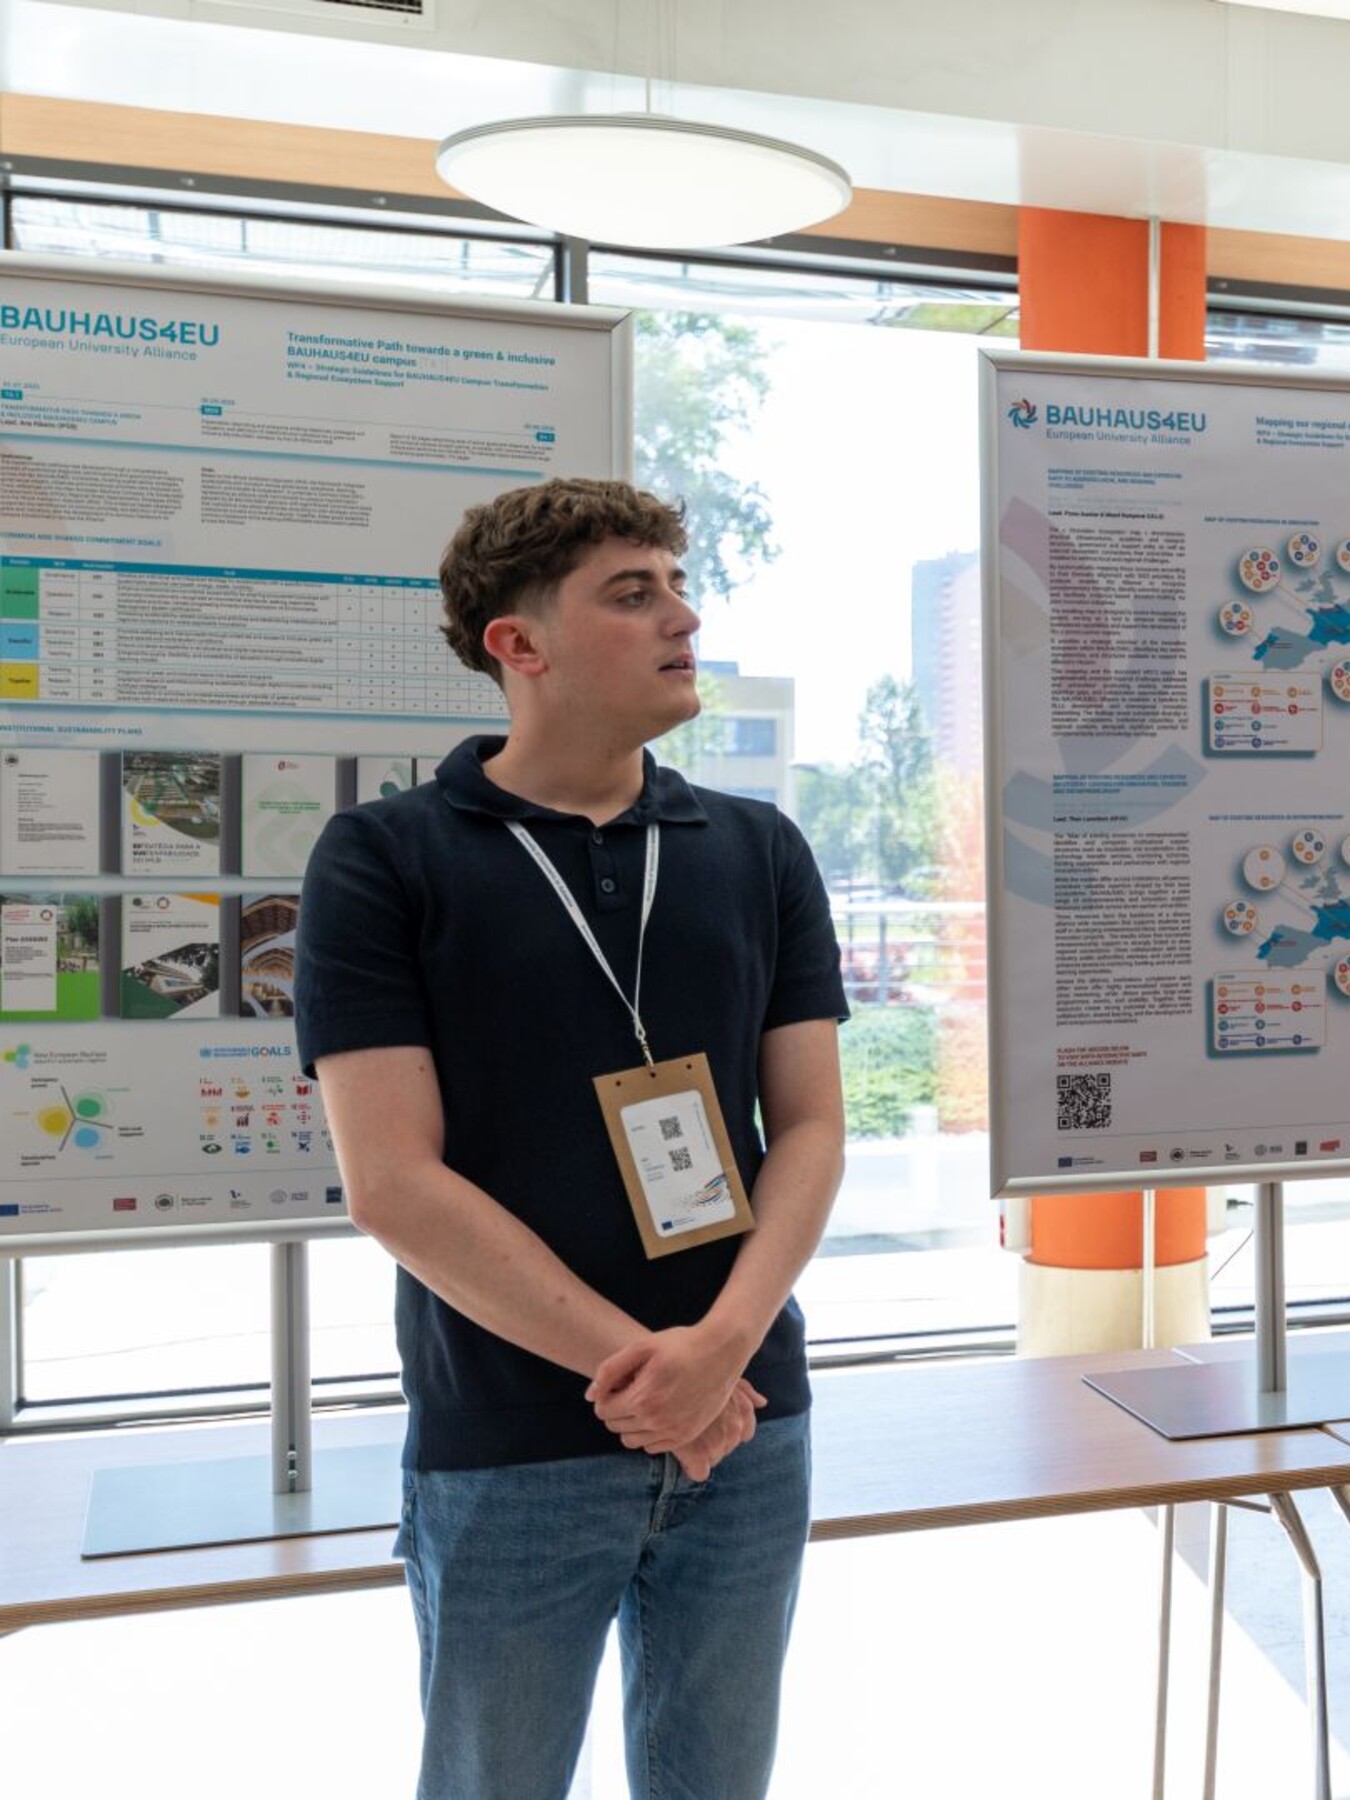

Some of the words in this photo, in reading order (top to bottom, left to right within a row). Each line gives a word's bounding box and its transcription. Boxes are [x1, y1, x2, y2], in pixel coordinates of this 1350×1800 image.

[0, 305, 220, 347] BAUHAUS4EU
[0, 333, 64, 350] European
[69, 338, 139, 357] University
[143, 345, 198, 361] Alliance
[287, 331, 375, 349] Transformative
[377, 339, 404, 352] Path
[406, 342, 450, 357] towards
[453, 348, 461, 357] a
[463, 348, 494, 362] green
[496, 351, 505, 361] &
[508, 352, 556, 366] inclusive
[287, 345, 370, 363] BAUHAUS4EU
[373, 353, 417, 369] campus
[1046, 405, 1206, 432] BAUHAUS4EU
[1256, 416, 1294, 429] Mapping
[1046, 429, 1094, 442] European
[1096, 432, 1149, 445] University
[1151, 435, 1192, 445] Alliance
[250, 1046, 292, 1057] GOALS
